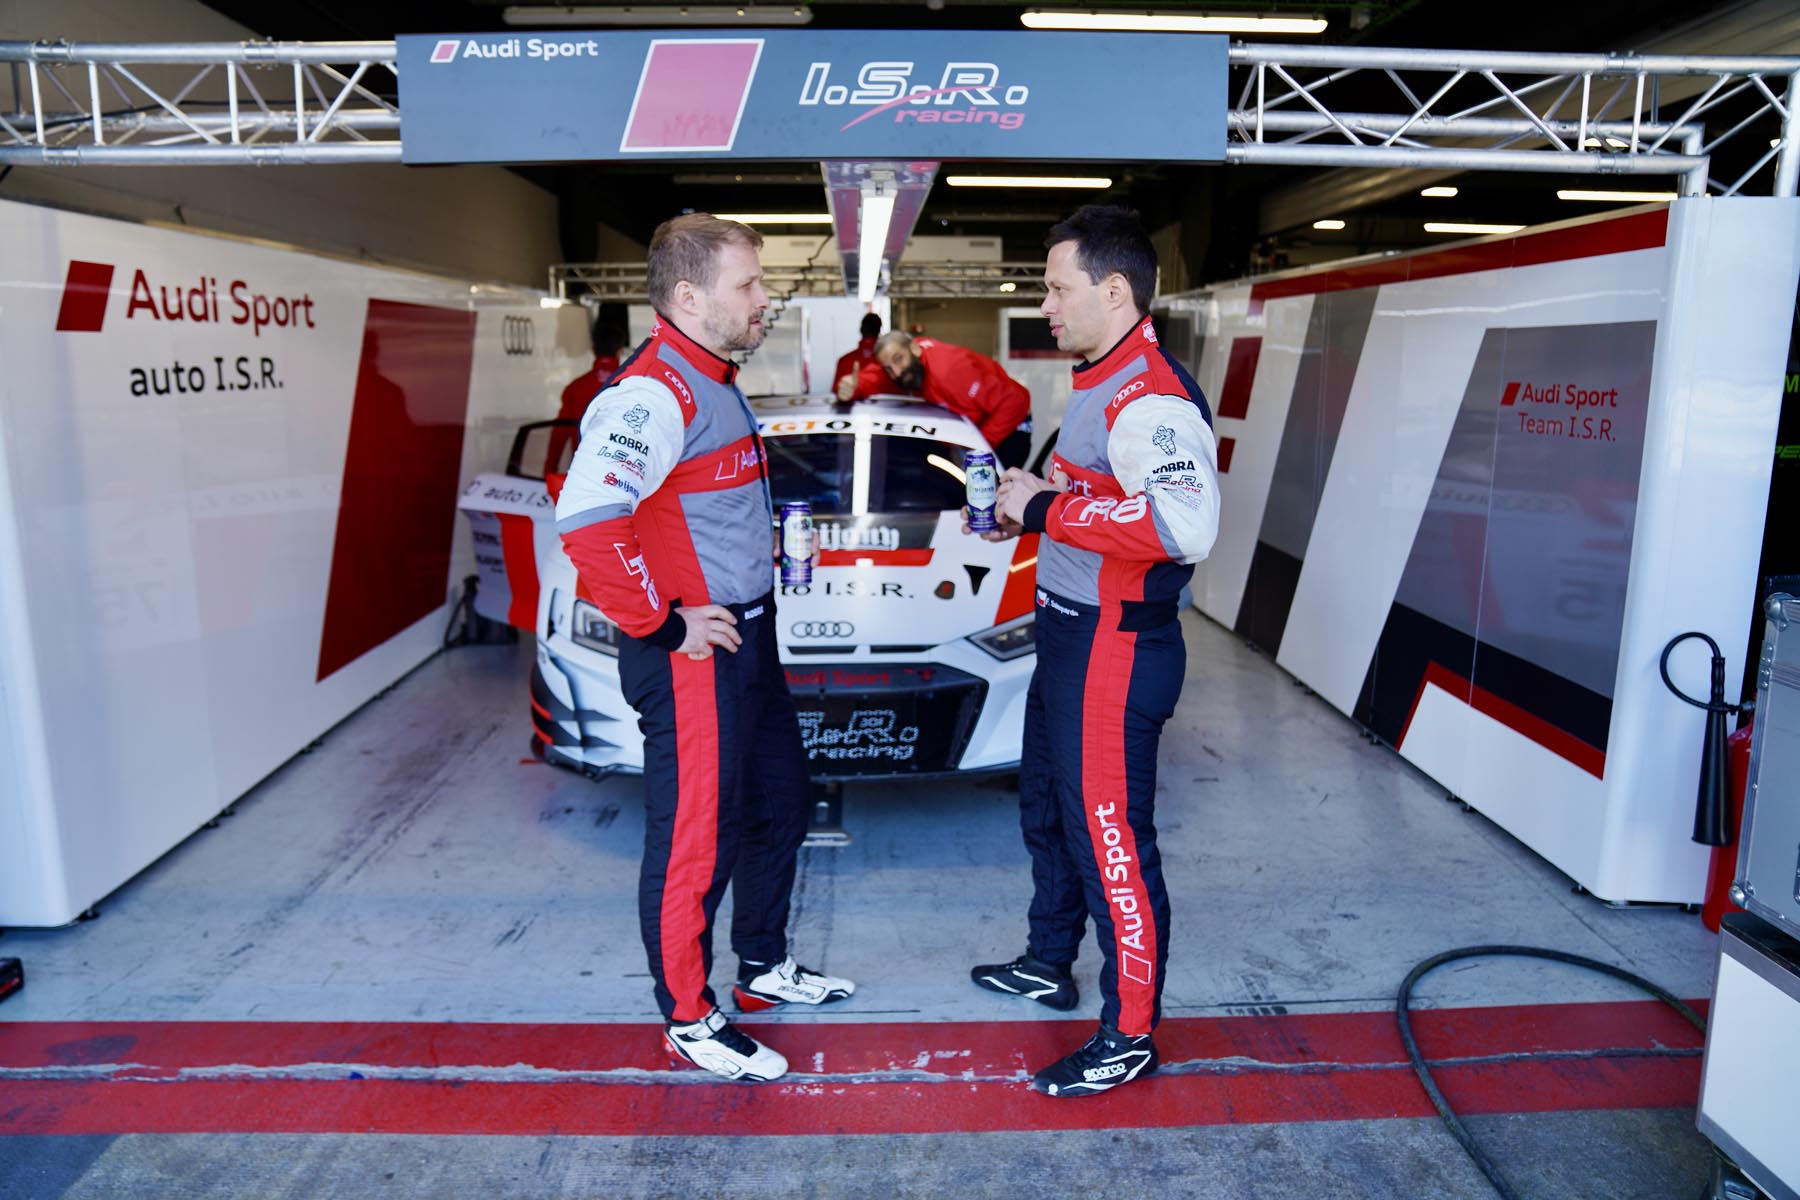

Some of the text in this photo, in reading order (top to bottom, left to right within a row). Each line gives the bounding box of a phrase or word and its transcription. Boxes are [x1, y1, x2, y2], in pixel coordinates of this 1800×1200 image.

[463, 39, 599, 61] Audi Sport
[894, 107, 1025, 129] racing
[126, 269, 315, 337] Audi Sport
[130, 356, 284, 396] auto I.S.R.
[1522, 382, 1618, 411] Audi Sport
[825, 421, 937, 436] OEN
[1518, 411, 1616, 442] Team I.S.R.
[609, 433, 649, 456] KOBRA
[832, 669, 892, 687] Sport
[1095, 801, 1146, 951] Audi Sport
[1083, 1063, 1126, 1081] sparco
